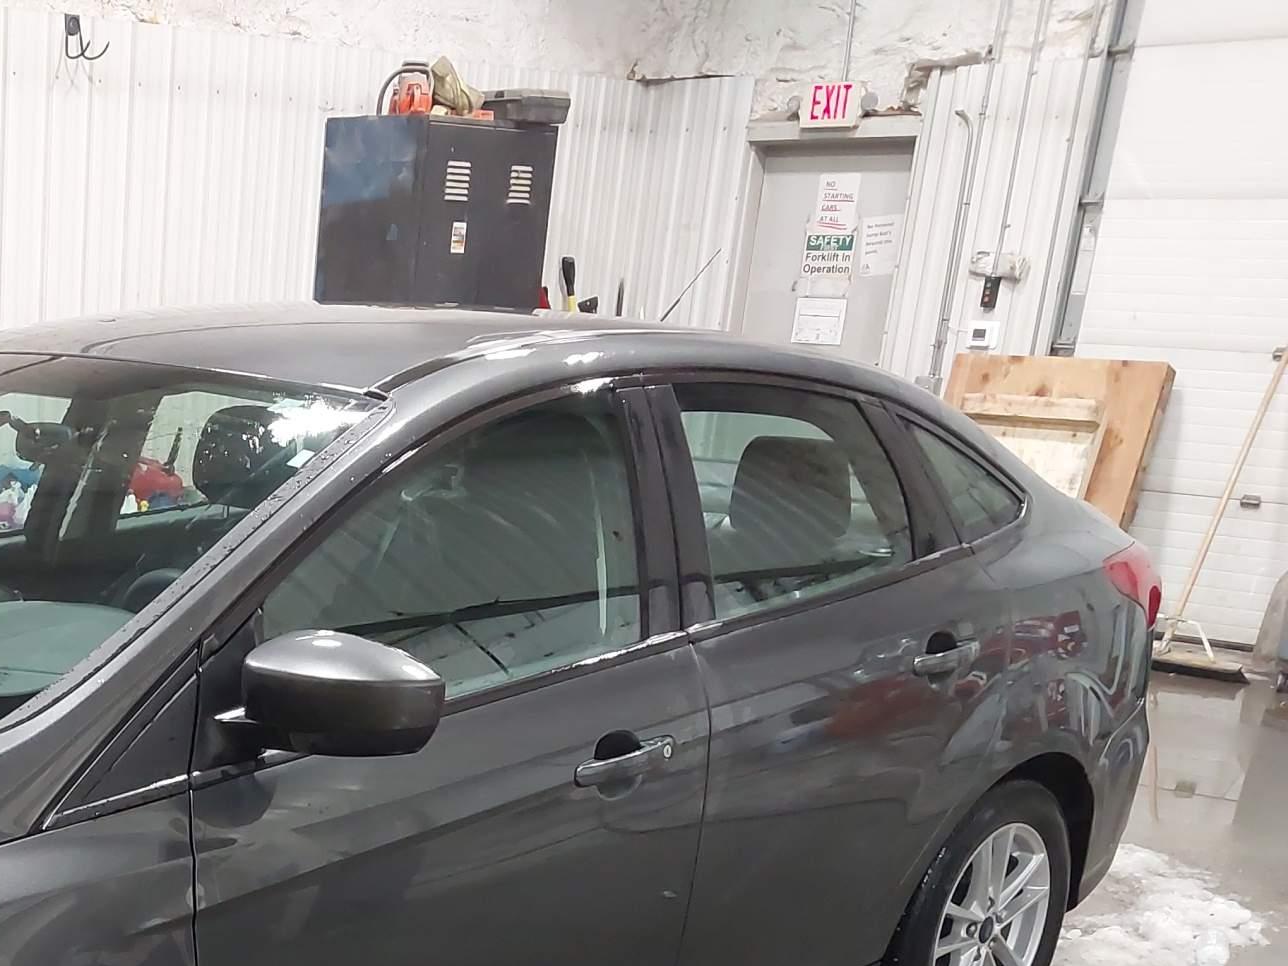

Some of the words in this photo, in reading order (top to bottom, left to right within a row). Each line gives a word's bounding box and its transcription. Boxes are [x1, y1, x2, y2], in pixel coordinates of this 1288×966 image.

[811, 84, 852, 120] EXIT
[809, 235, 852, 246] SAFETY
[805, 253, 839, 262] Forklift
[803, 264, 850, 275] Operation
